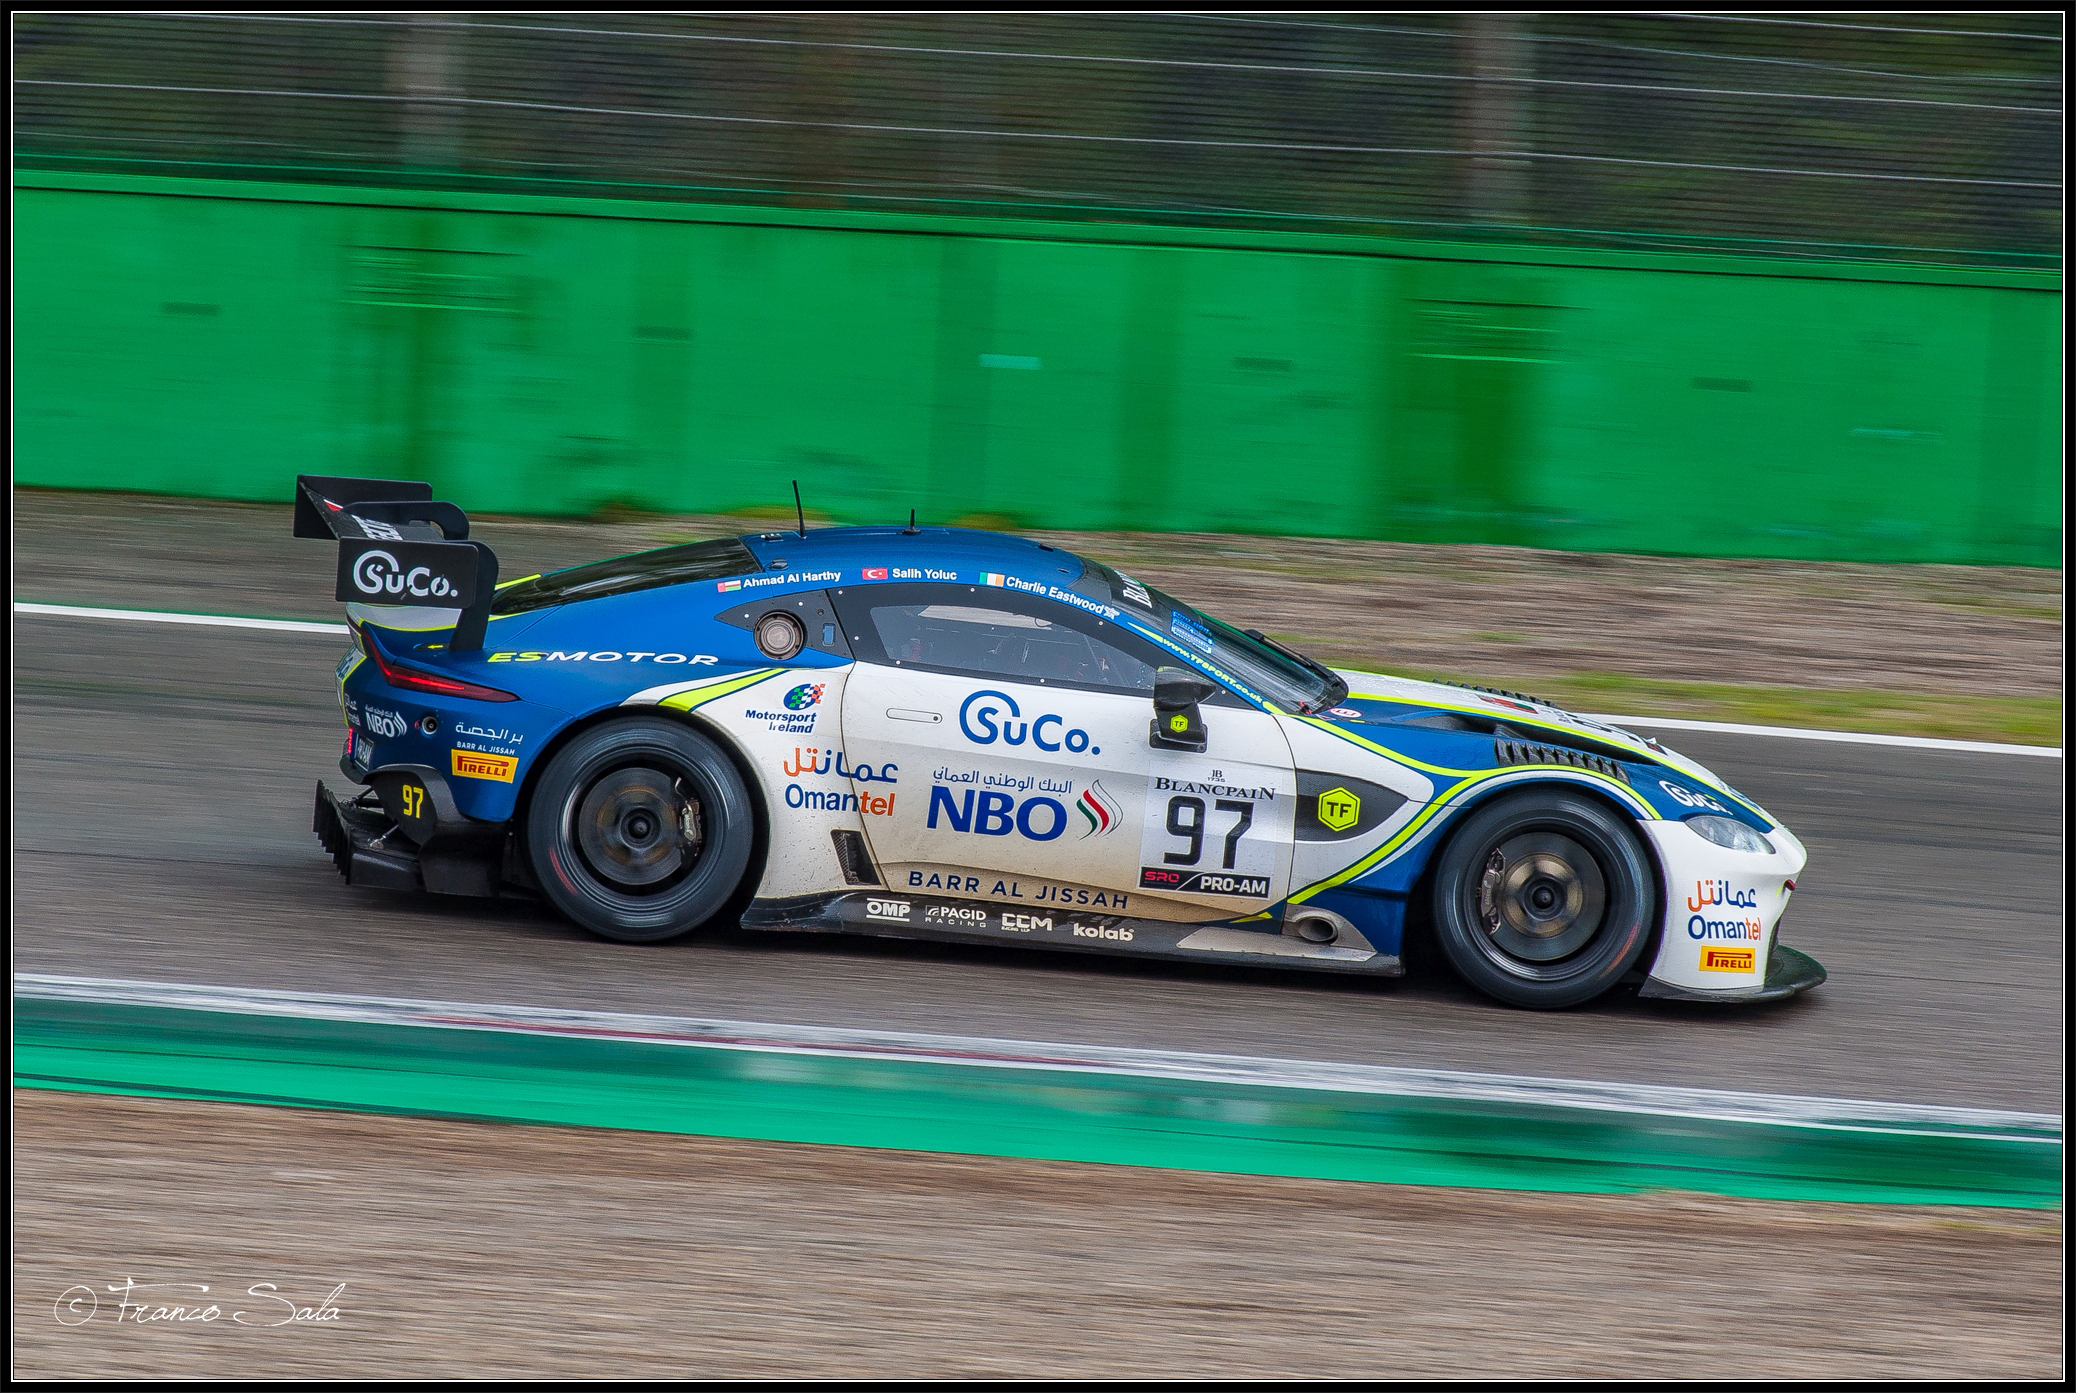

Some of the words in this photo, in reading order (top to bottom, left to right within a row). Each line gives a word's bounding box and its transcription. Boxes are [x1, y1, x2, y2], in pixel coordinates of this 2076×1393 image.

[743, 574, 784, 588] Ahmad
[787, 573, 800, 583] Al
[802, 571, 841, 583] Harthy
[892, 568, 923, 579] Salih
[925, 569, 958, 580] Yoluc
[1006, 576, 1047, 595] Charlie
[1048, 586, 1104, 615] Eastwood
[487, 651, 719, 666] ESMOTOR
[1163, 639, 1263, 703] www.TFSPORT.co.uk
[365, 711, 396, 738] NBO
[745, 709, 817, 723] Motorsport
[959, 690, 1101, 755] SuCo.
[1174, 720, 1184, 728] TF
[455, 722, 509, 740] الجصة
[768, 722, 814, 734] Ireland
[456, 740, 476, 750] BARR
[477, 744, 487, 752] AL
[489, 746, 516, 755] JISSAH
[457, 755, 510, 777] PIRELLI
[783, 747, 899, 783] عمانتل
[1154, 776, 1276, 801] BLANCPAIN
[402, 784, 424, 819] 97
[785, 783, 896, 817] Omantel
[1326, 801, 1352, 818] TF
[926, 785, 1068, 842] NBO
[1163, 795, 1254, 870] 97
[1144, 871, 1180, 884] SRO
[1200, 875, 1267, 894] PRO-AM
[909, 870, 981, 893] BARR
[991, 880, 1023, 898] AL
[1035, 885, 1129, 909] JISSAH
[1687, 879, 1757, 912] عمانتل
[867, 901, 911, 918] OMP
[940, 906, 987, 921] PAGID
[924, 917, 987, 928] RACING
[1002, 913, 1053, 931] CCM
[1687, 915, 1762, 941] Omantel
[1073, 922, 1130, 942] kolab
[1706, 951, 1752, 969] PIRELLI
